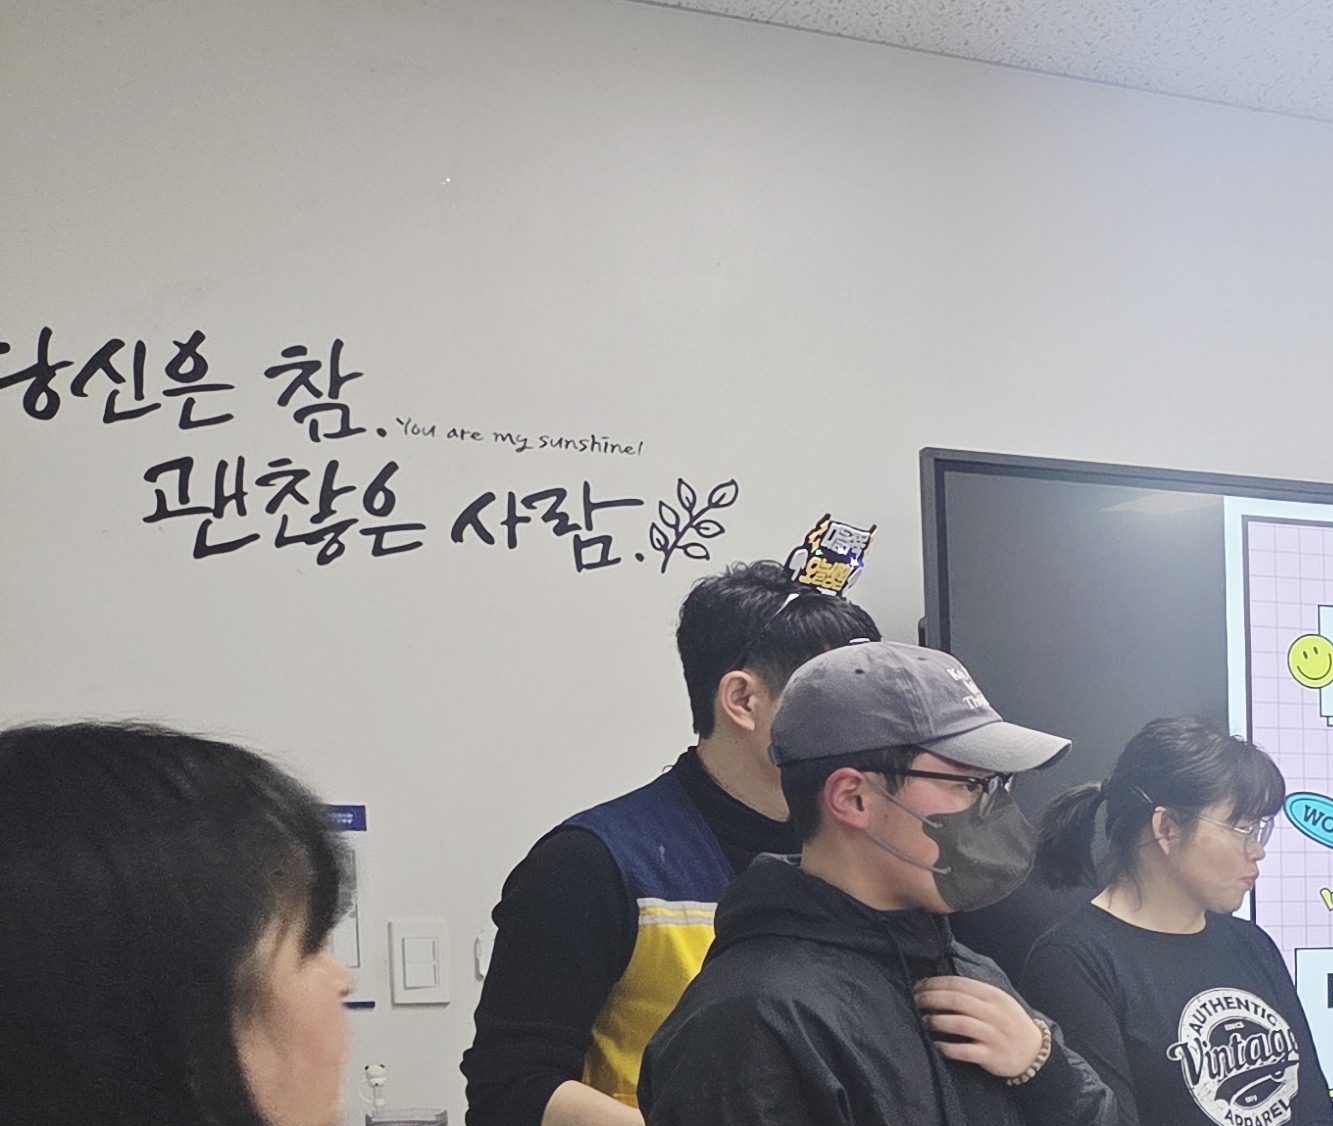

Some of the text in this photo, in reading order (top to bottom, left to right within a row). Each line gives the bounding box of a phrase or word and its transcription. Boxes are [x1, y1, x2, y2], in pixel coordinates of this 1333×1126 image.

[264, 338, 387, 442] 참.
[396, 416, 437, 437] You
[446, 427, 485, 442] are
[493, 431, 533, 453] my
[143, 455, 645, 573] 괜찮은 사람.
[1188, 996, 1279, 1036] AUTHENTIC
